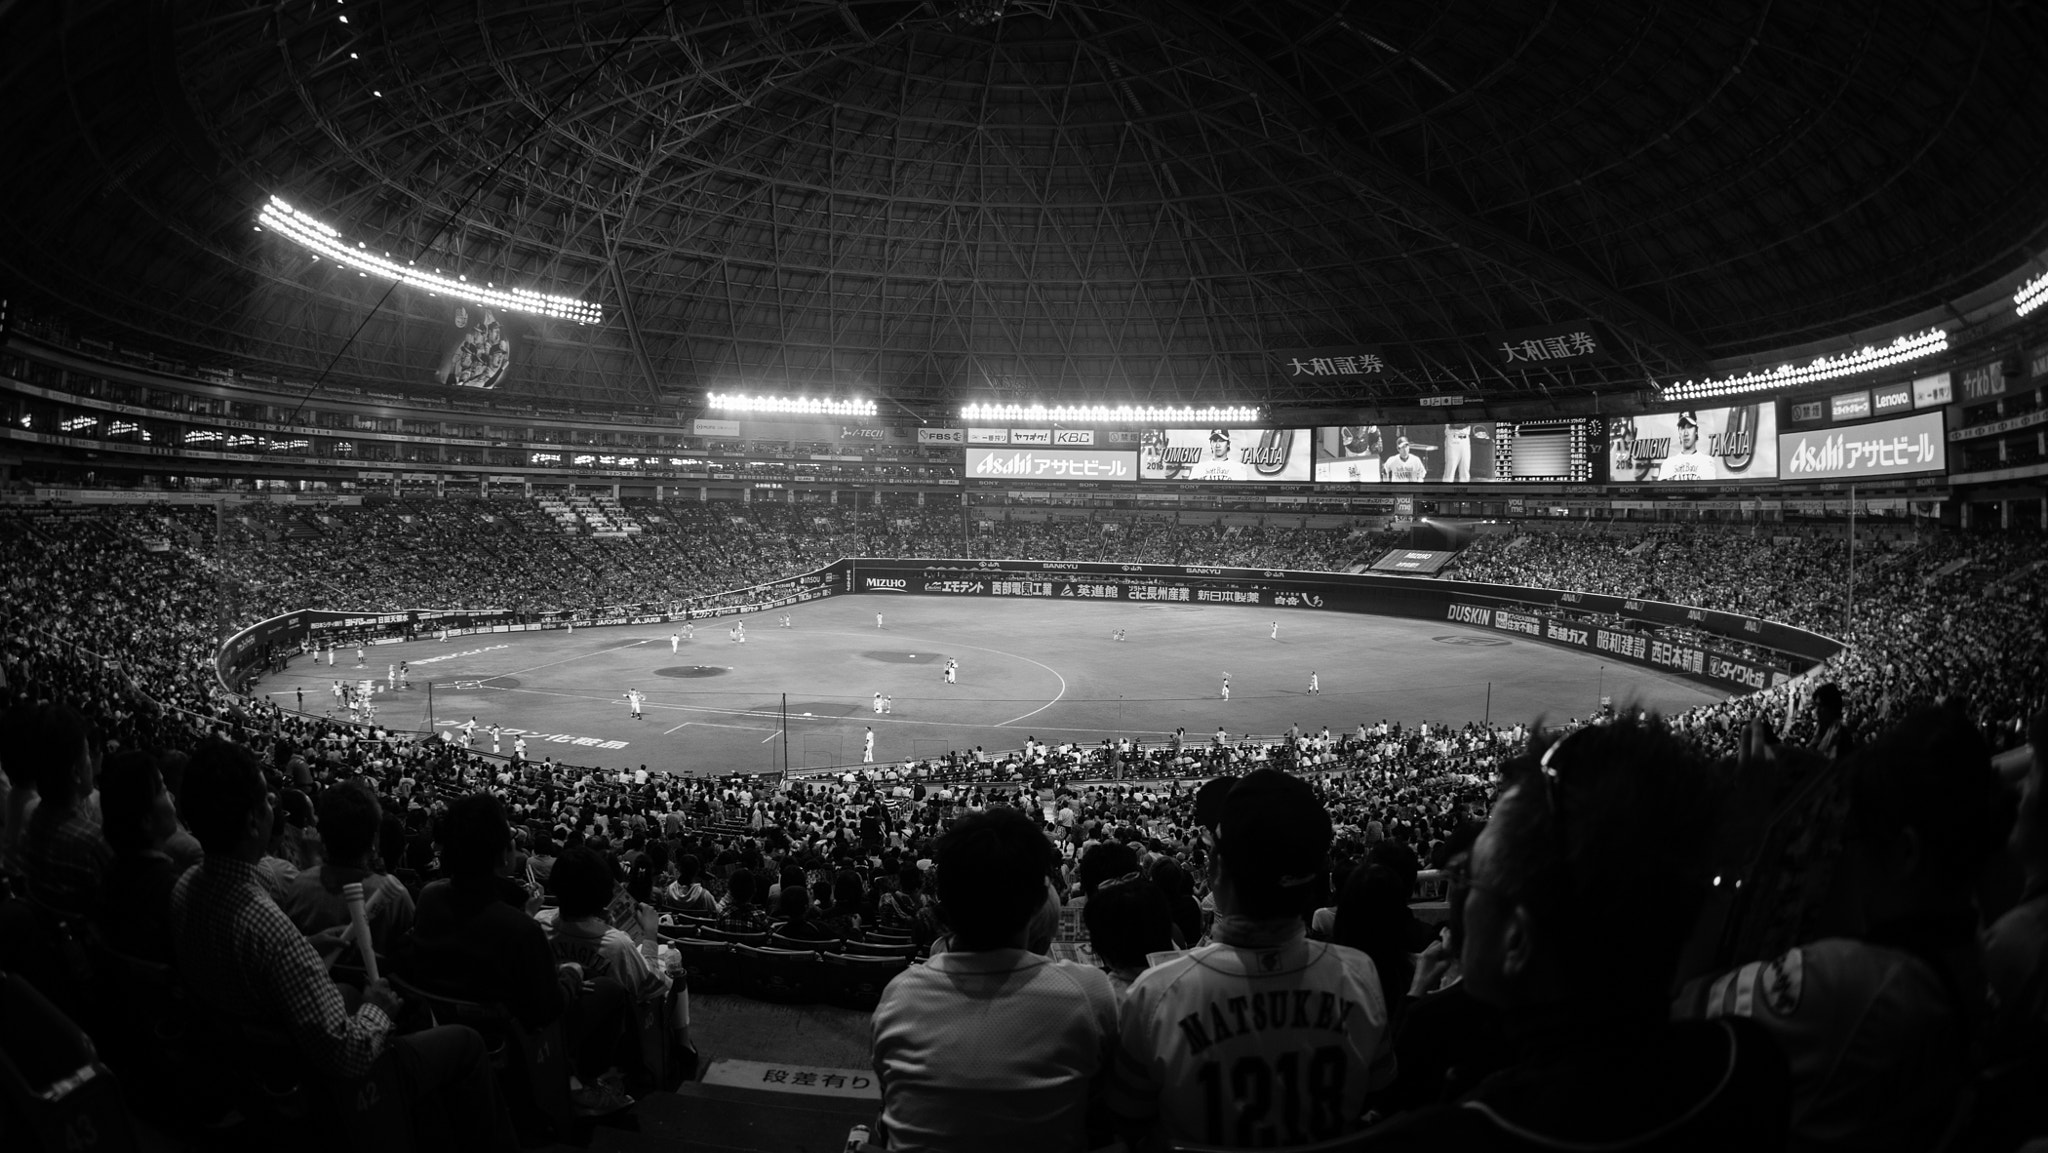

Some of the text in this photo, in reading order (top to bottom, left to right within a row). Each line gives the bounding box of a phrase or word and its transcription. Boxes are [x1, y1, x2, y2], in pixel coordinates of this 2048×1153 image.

[1498, 331, 1597, 364] 大和証券
[1287, 354, 1384, 377] 大和証券
[1875, 391, 1909, 409] Lenovo
[1802, 404, 1820, 418] 禁煙
[929, 432, 951, 441] FBS
[1057, 432, 1090, 443] KBC
[1627, 431, 1750, 460] TOMOKI TAKATA
[1789, 432, 1935, 473] Asahi アサヒビール
[1160, 447, 1284, 465] TOMOKI TAKATA
[976, 452, 1127, 476] Asahi アサヒビール
[1146, 462, 1164, 471] 2016
[1615, 460, 1634, 470] 2016
[1916, 479, 1936, 487] SONY
[1396, 497, 1411, 505] you
[1508, 498, 1523, 507] you
[1042, 562, 1079, 570] SANKYU
[1186, 567, 1221, 575] SANKYU
[866, 577, 907, 588] MIZUHO
[942, 581, 984, 593] エモテント
[992, 581, 1052, 597] 西部電気工業
[1077, 583, 1119, 598] 英進館
[1146, 587, 1190, 601] 長州産業
[1197, 589, 1259, 603] 新日本製薬
[1561, 594, 1577, 603] ANA
[1624, 601, 1638, 610] ANA
[1447, 603, 1491, 626] DUSKIN
[1687, 609, 1701, 621] ANA
[1508, 621, 1540, 636] 住友不動産
[1547, 625, 1588, 646] 西部ガス
[1596, 629, 1646, 660] 昭和建設
[1651, 640, 1704, 675] 西日本新聞
[1719, 660, 1766, 690] ダイワ化成
[762, 1069, 870, 1090] 段差有り
